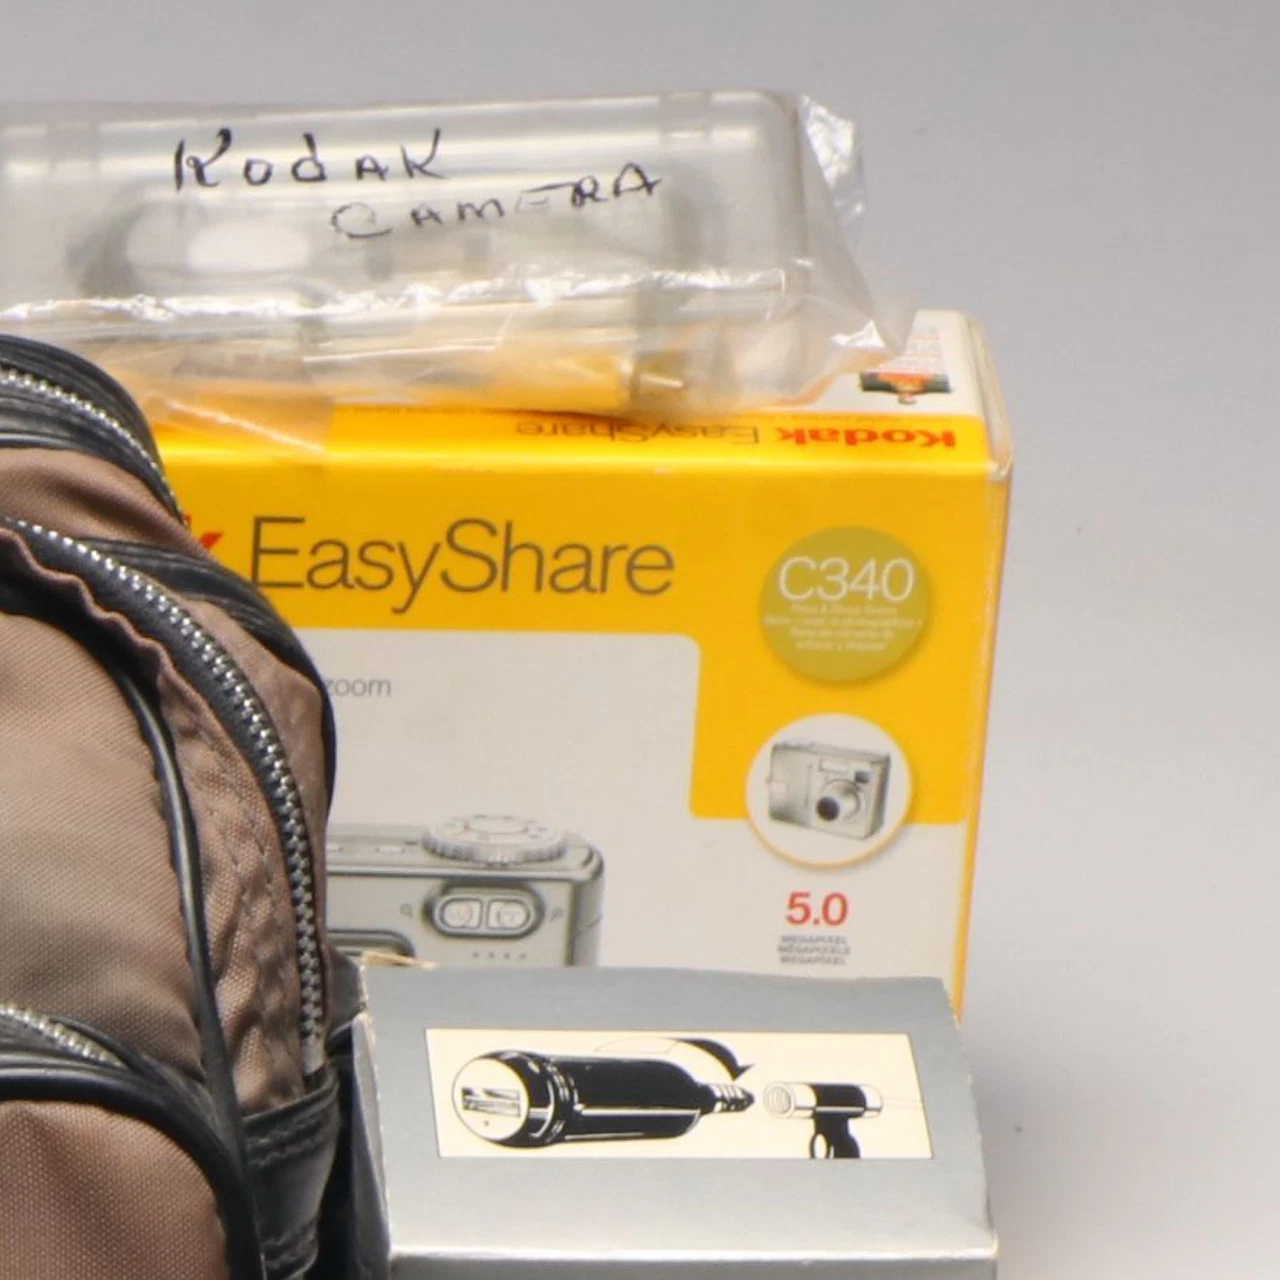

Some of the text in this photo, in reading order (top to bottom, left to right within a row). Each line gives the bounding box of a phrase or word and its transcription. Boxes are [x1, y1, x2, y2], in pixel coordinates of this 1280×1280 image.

[517, 422, 956, 448] Kodak EasyShare
[250, 515, 675, 615] EasyShare
[777, 556, 916, 604] C340
[785, 889, 850, 927] 5.0
